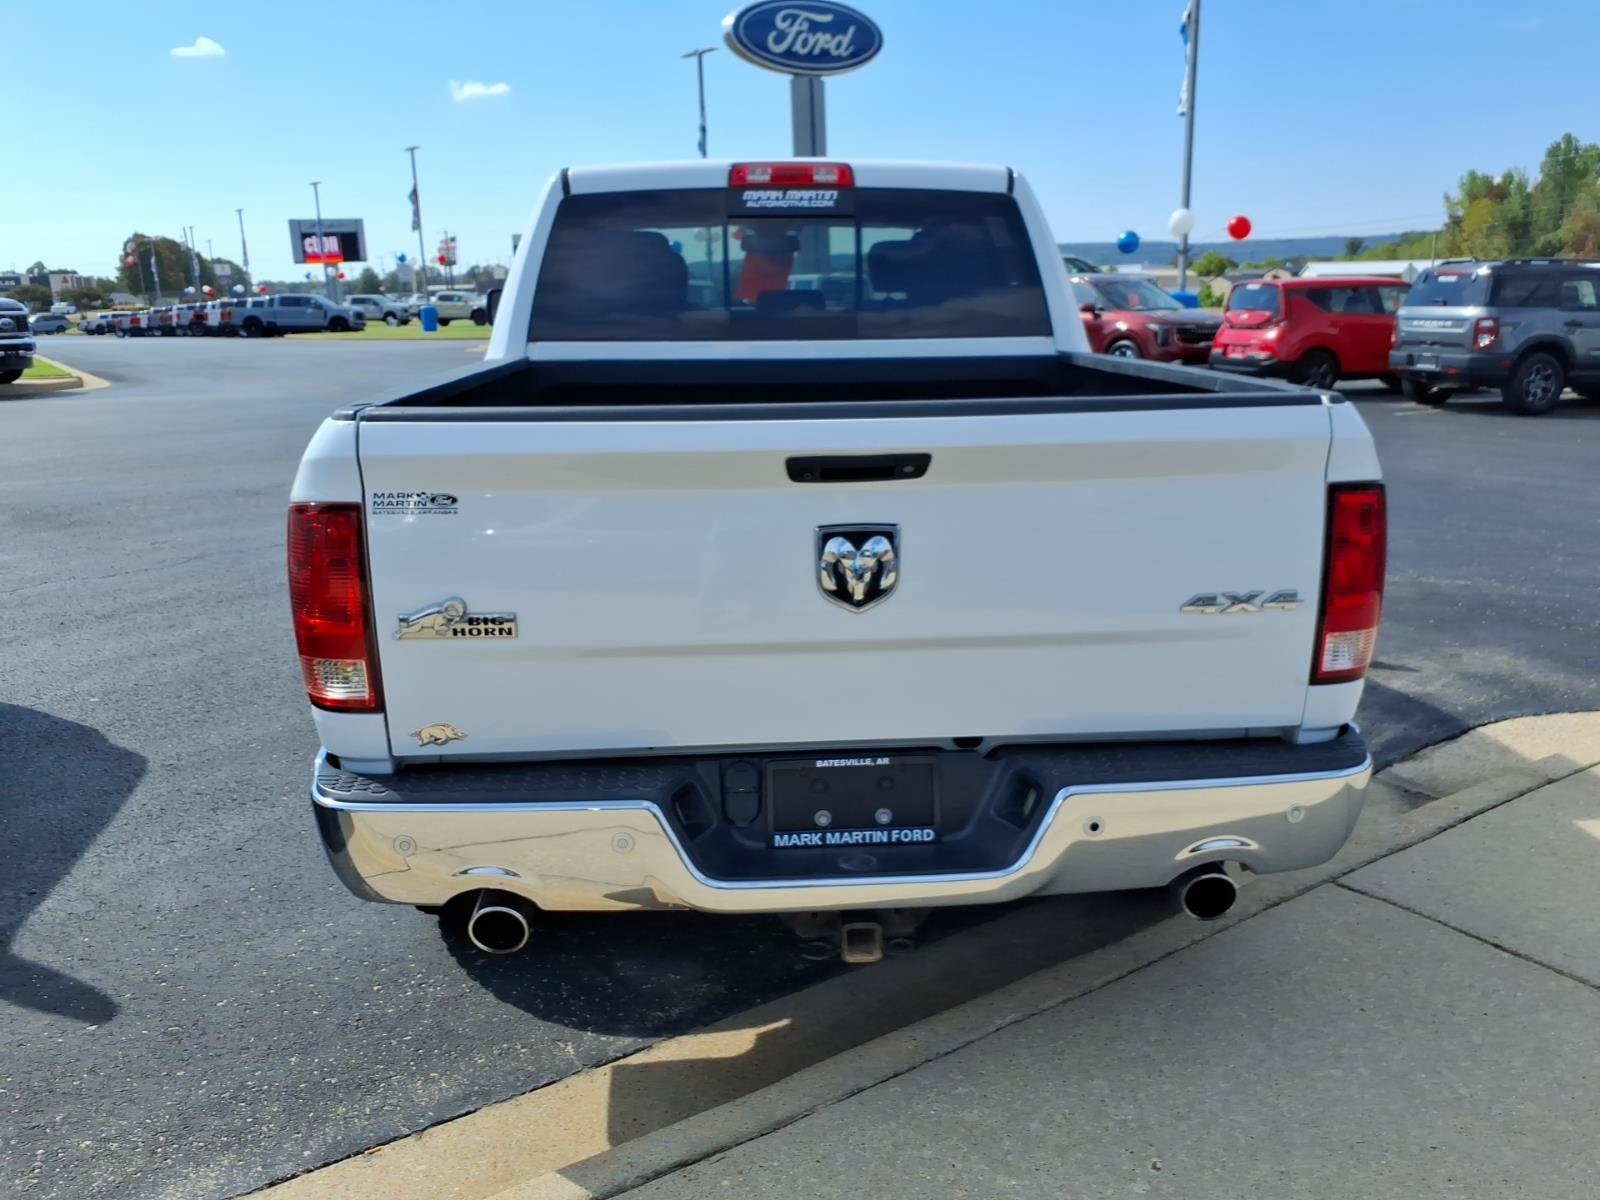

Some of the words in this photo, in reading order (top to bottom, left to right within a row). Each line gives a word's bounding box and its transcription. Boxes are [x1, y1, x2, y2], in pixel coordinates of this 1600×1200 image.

[767, 8, 856, 57] Ford
[743, 190, 783, 200] MARK
[785, 190, 838, 200] MARTIN
[468, 616, 505, 626] BIG
[453, 628, 512, 636] HORN
[876, 757, 890, 765] AR
[774, 833, 822, 847] MARK
[825, 831, 888, 845] MARTIN
[891, 829, 935, 842] FORD
